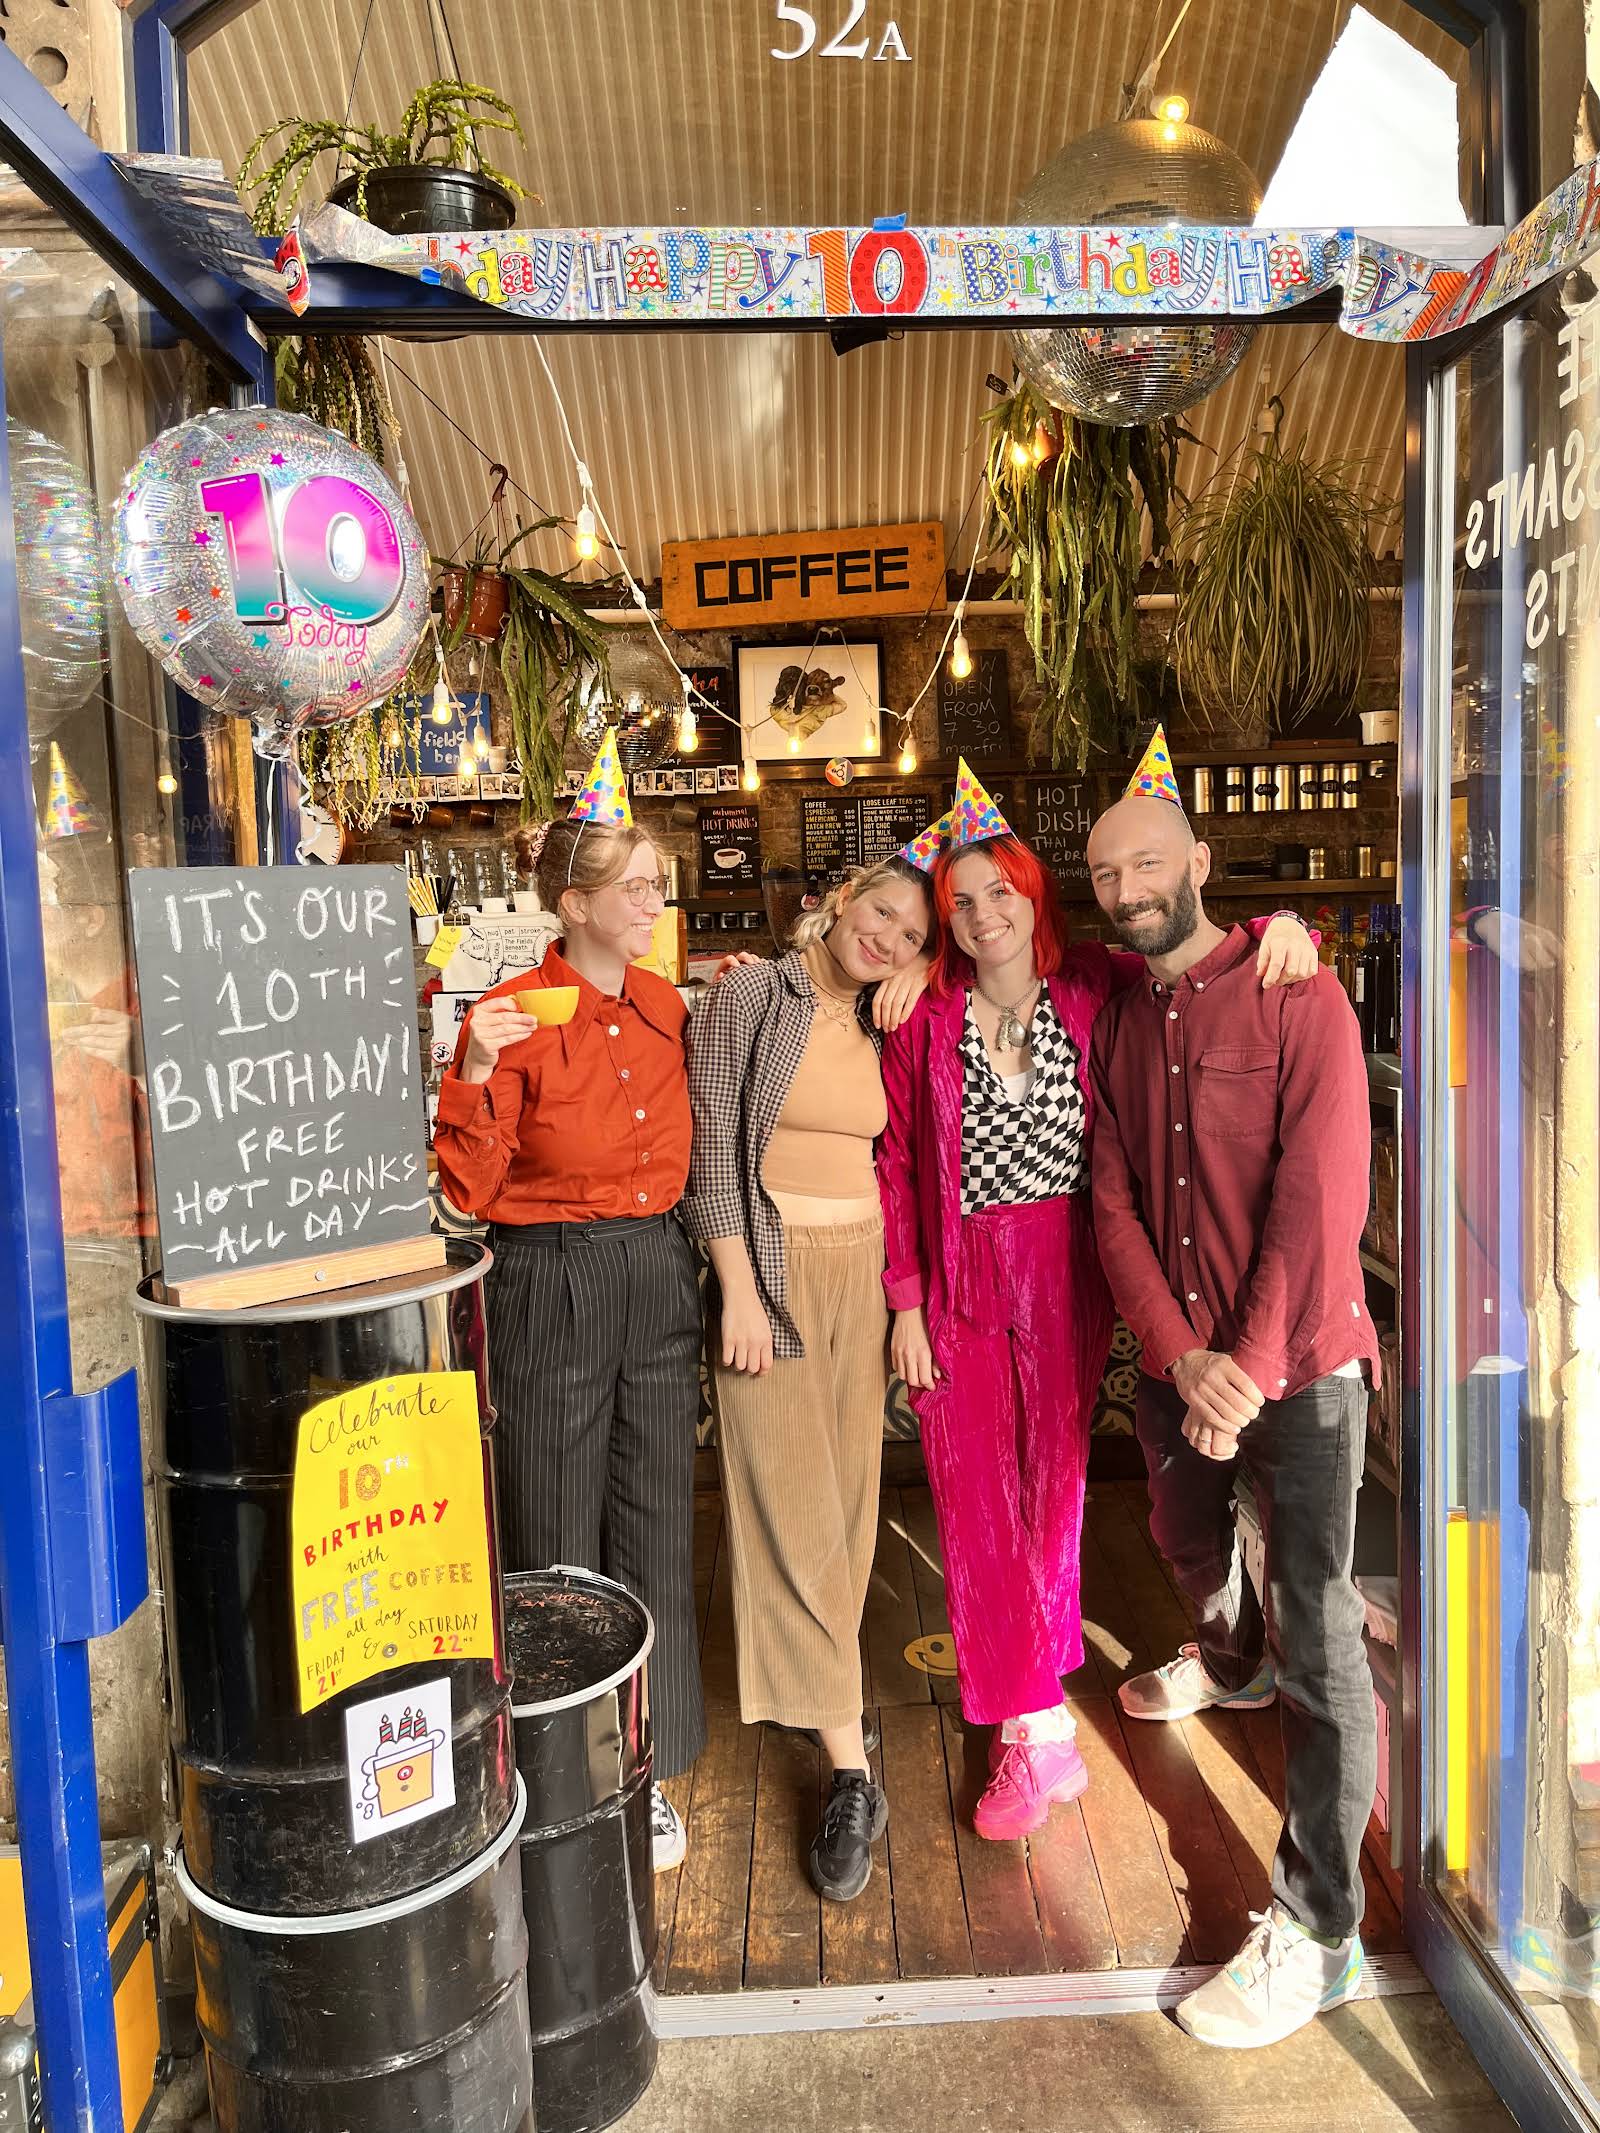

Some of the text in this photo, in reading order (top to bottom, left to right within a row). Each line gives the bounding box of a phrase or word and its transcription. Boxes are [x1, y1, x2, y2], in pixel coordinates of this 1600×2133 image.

[769, 0, 912, 61] 52A
[580, 229, 803, 312] Happy
[957, 230, 1220, 310] Birthday
[198, 467, 407, 627] 10
[694, 546, 909, 608] COFFEE
[265, 602, 368, 666] Today
[943, 675, 993, 697] OPEN
[943, 698, 996, 719] FROM
[804, 801, 827, 809] COFFEE
[862, 799, 881, 807] LOOSE
[882, 798, 897, 806] LEAF
[898, 797, 913, 805] TEAS
[804, 808, 835, 816] ESPRESSO
[1037, 784, 1082, 807] HOT
[702, 816, 758, 831] HOT DRINKS
[805, 815, 838, 823] AMERICANO
[1036, 808, 1091, 834] DISH
[806, 849, 841, 857] CAPPUCCINO
[1030, 835, 1066, 851] THAI
[806, 856, 825, 864] LATTE
[164, 880, 398, 953] IT'S OUR
[216, 966, 367, 1036] 10TH
[153, 1024, 410, 1133] BIRTHDAY!
[237, 1111, 346, 1174] FREE
[173, 1152, 418, 1226] HOT DRINKS
[214, 1196, 373, 1264] ALL DAY
[309, 1382, 455, 1454] Celebrate
[347, 1434, 381, 1456] our
[303, 1498, 449, 1567] BIRTHDAY
[345, 1545, 390, 1574] with
[301, 1562, 473, 1641] FREE COFFEE
[346, 1607, 408, 1639] all day
[408, 1612, 478, 1640] SATURDAY
[306, 1646, 346, 1681] FRIDAY
